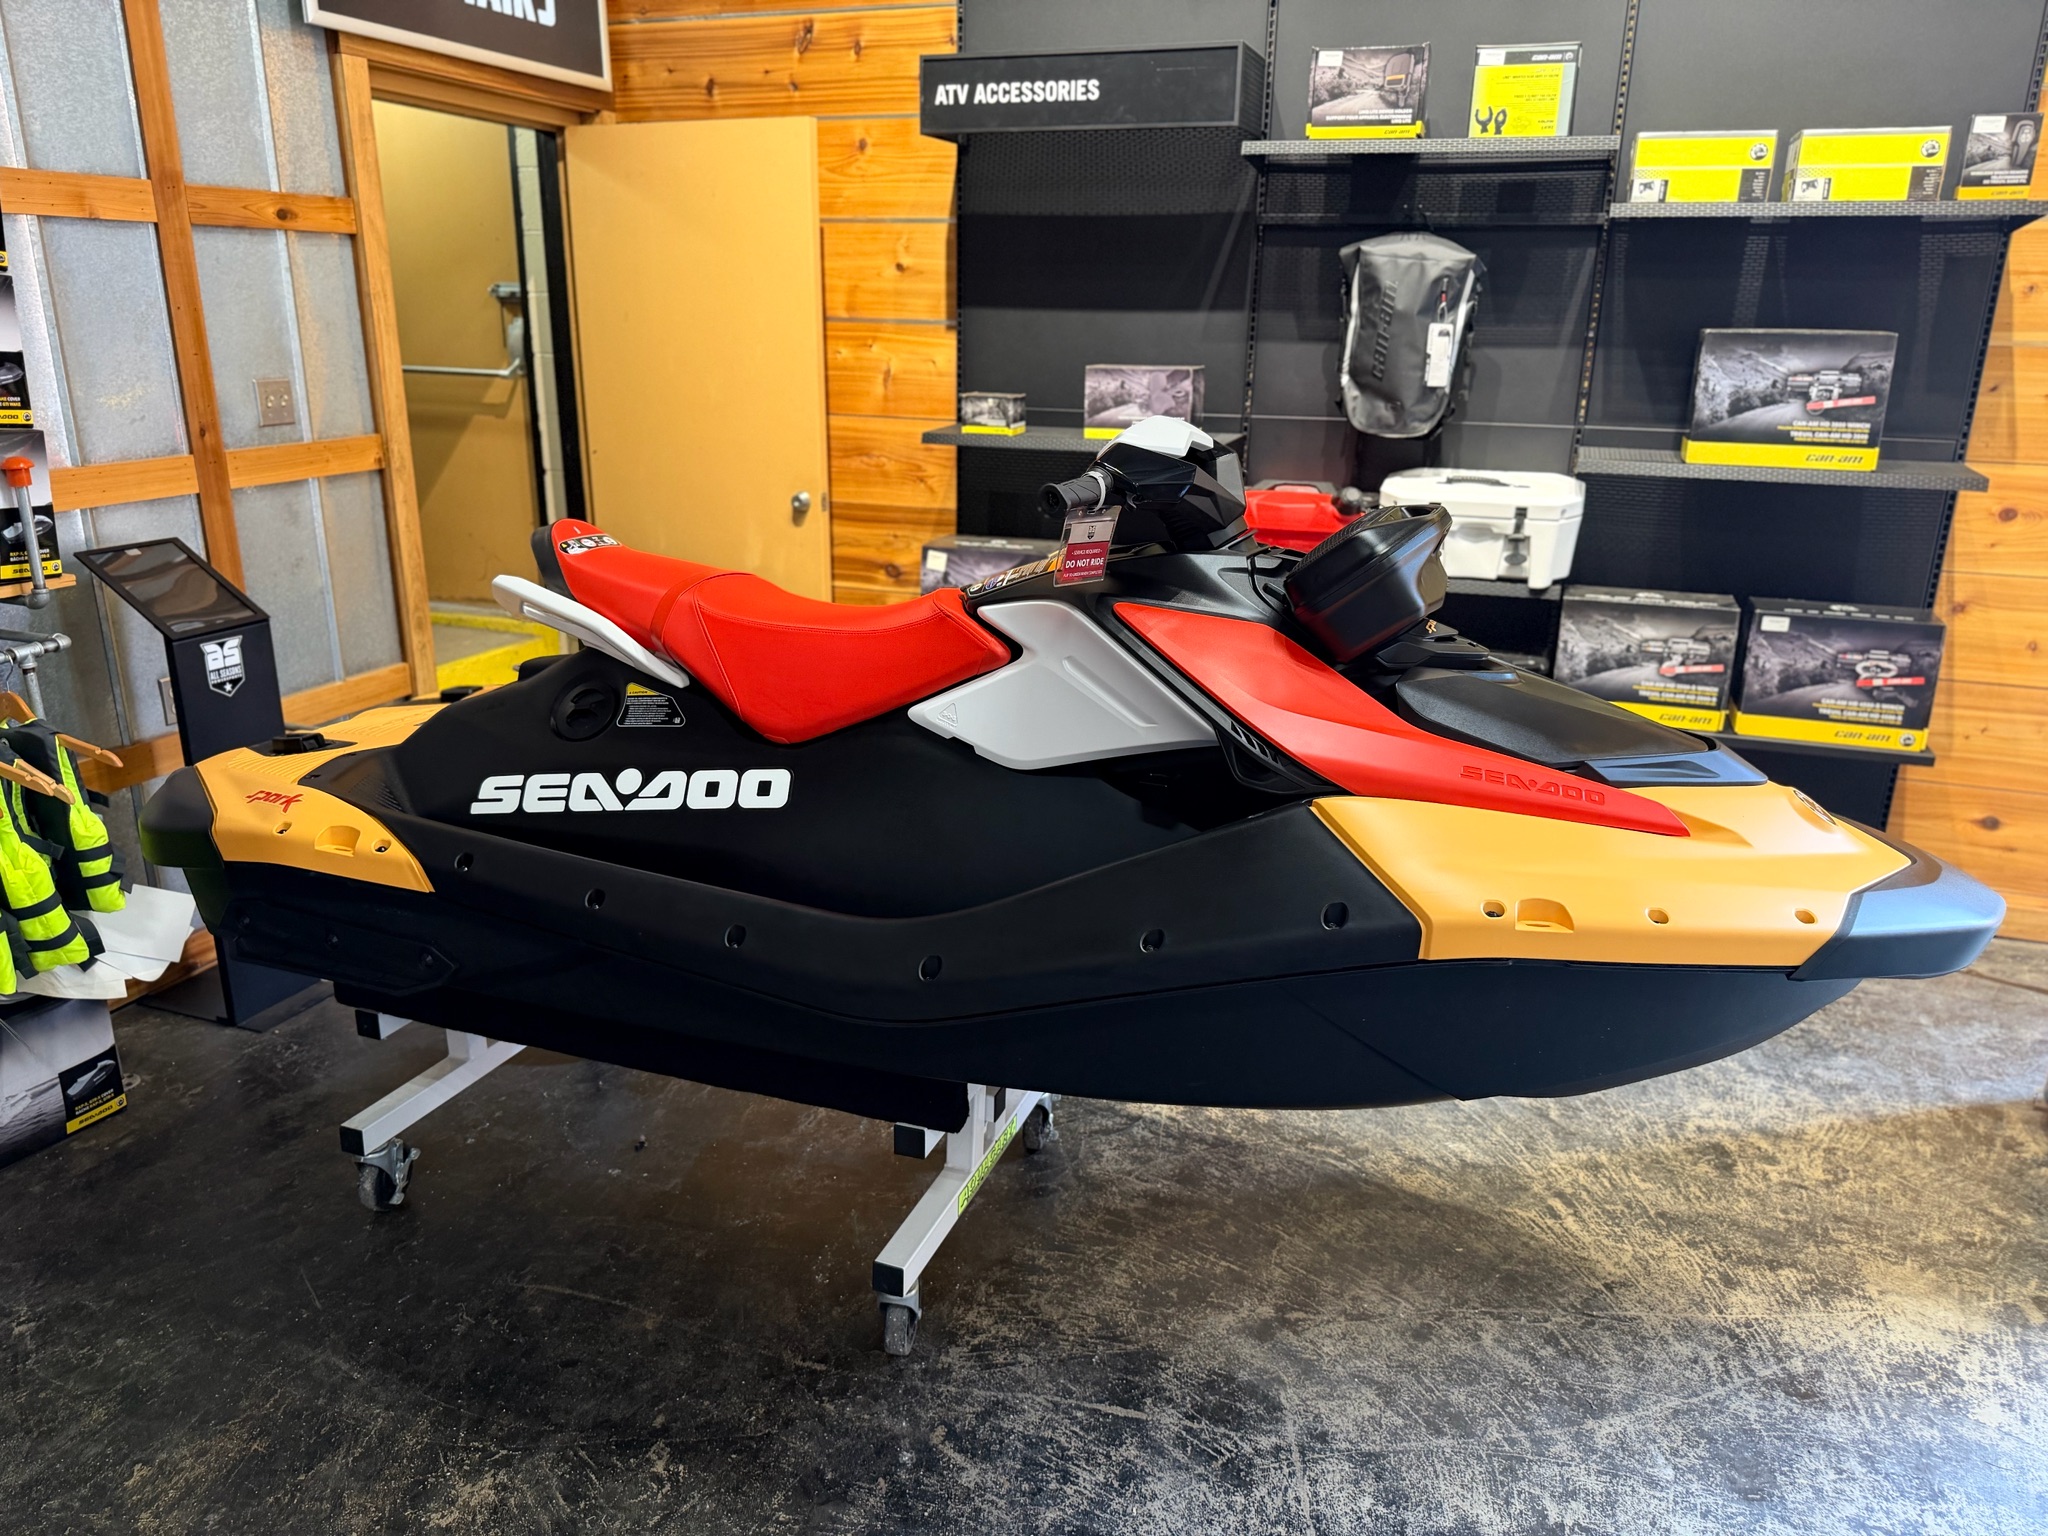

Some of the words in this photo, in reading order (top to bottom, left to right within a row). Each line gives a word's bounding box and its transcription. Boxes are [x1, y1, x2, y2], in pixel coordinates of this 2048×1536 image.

[934, 84, 969, 106] ATV
[973, 79, 1100, 105] ACCESSORIES
[1805, 453, 1864, 464] can-am
[1066, 560, 1075, 568] DO
[1076, 559, 1090, 567] NOT
[1090, 558, 1104, 566] RIDE
[210, 670, 220, 680] ALL
[219, 665, 242, 679] SEASONS
[1659, 713, 1712, 725] can-am
[1834, 730, 1891, 742] can-am
